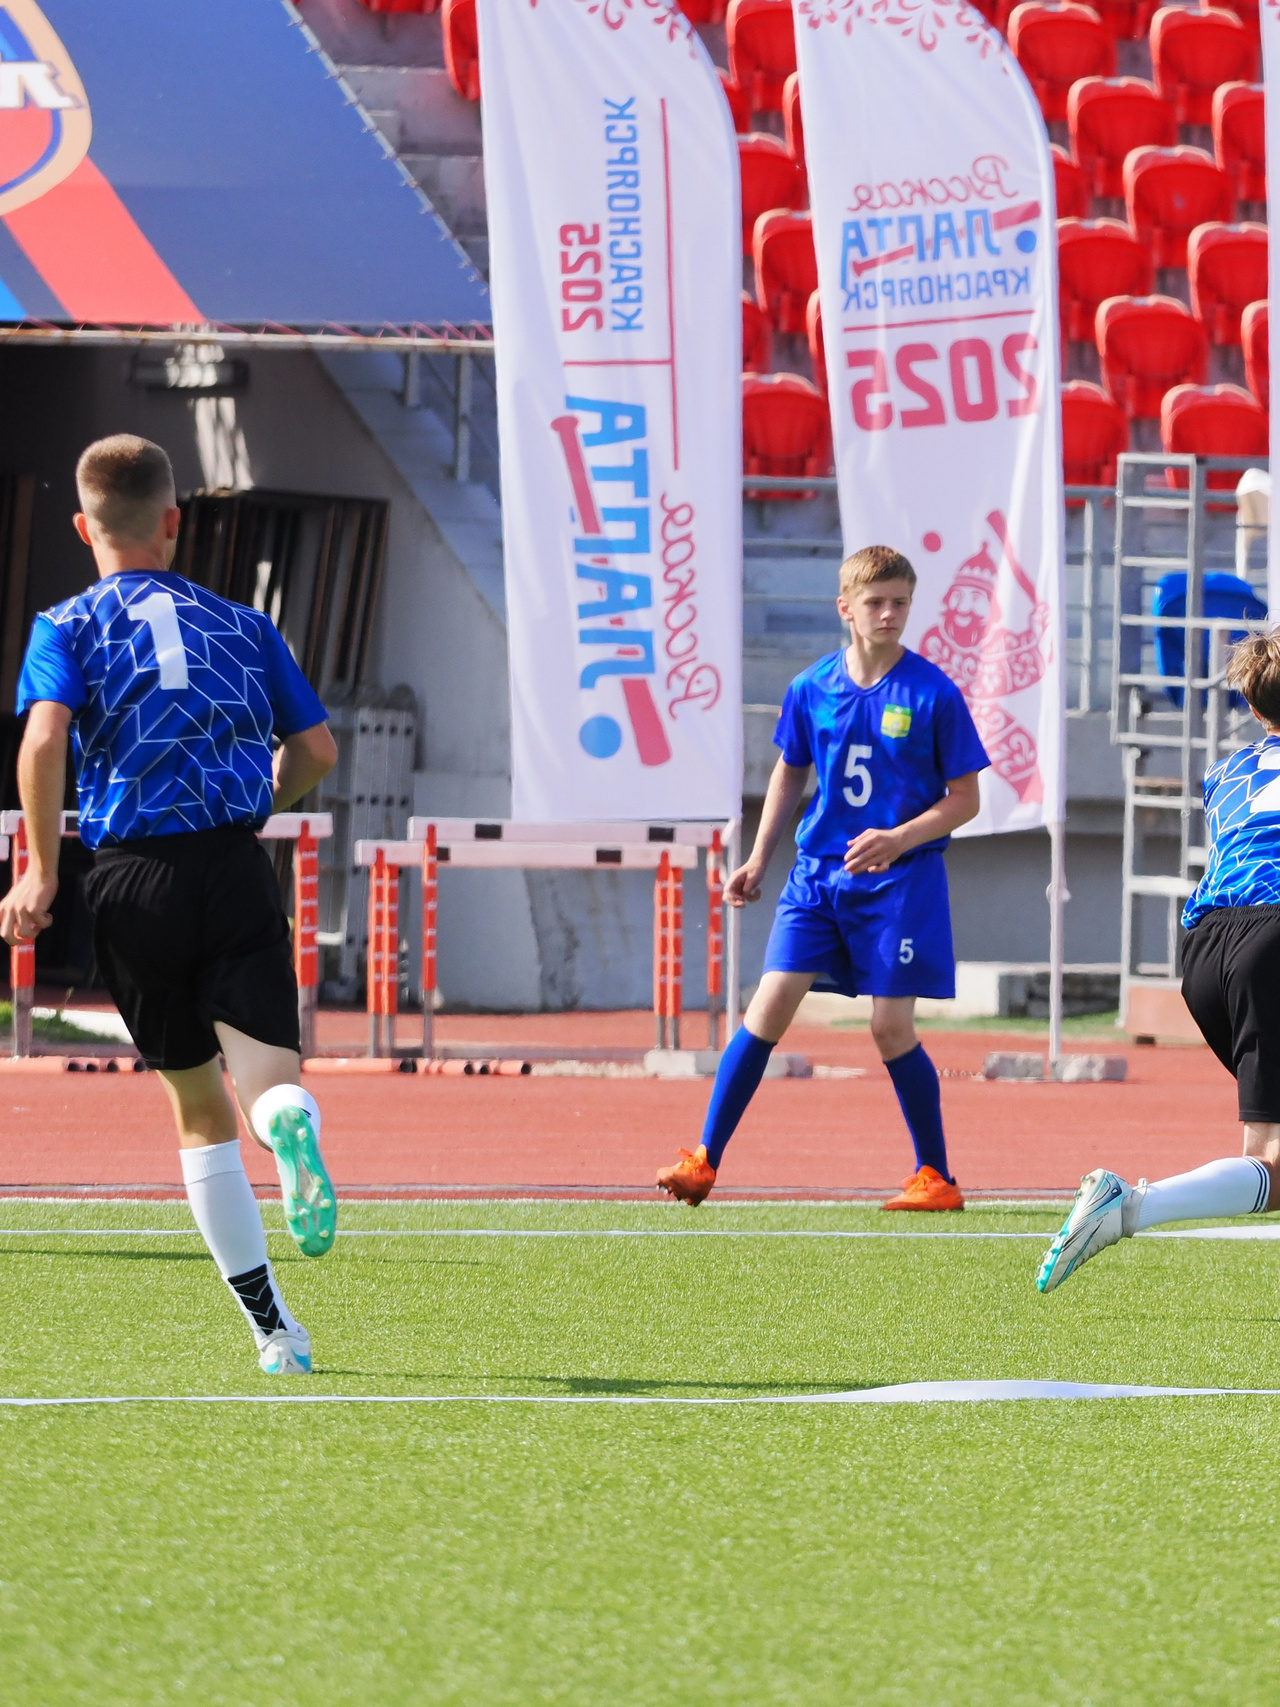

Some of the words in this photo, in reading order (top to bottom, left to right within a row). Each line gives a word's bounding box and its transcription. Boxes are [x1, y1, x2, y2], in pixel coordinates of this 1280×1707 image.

[127, 592, 189, 690] 1
[842, 744, 873, 808] 5
[898, 938, 914, 964] 5
